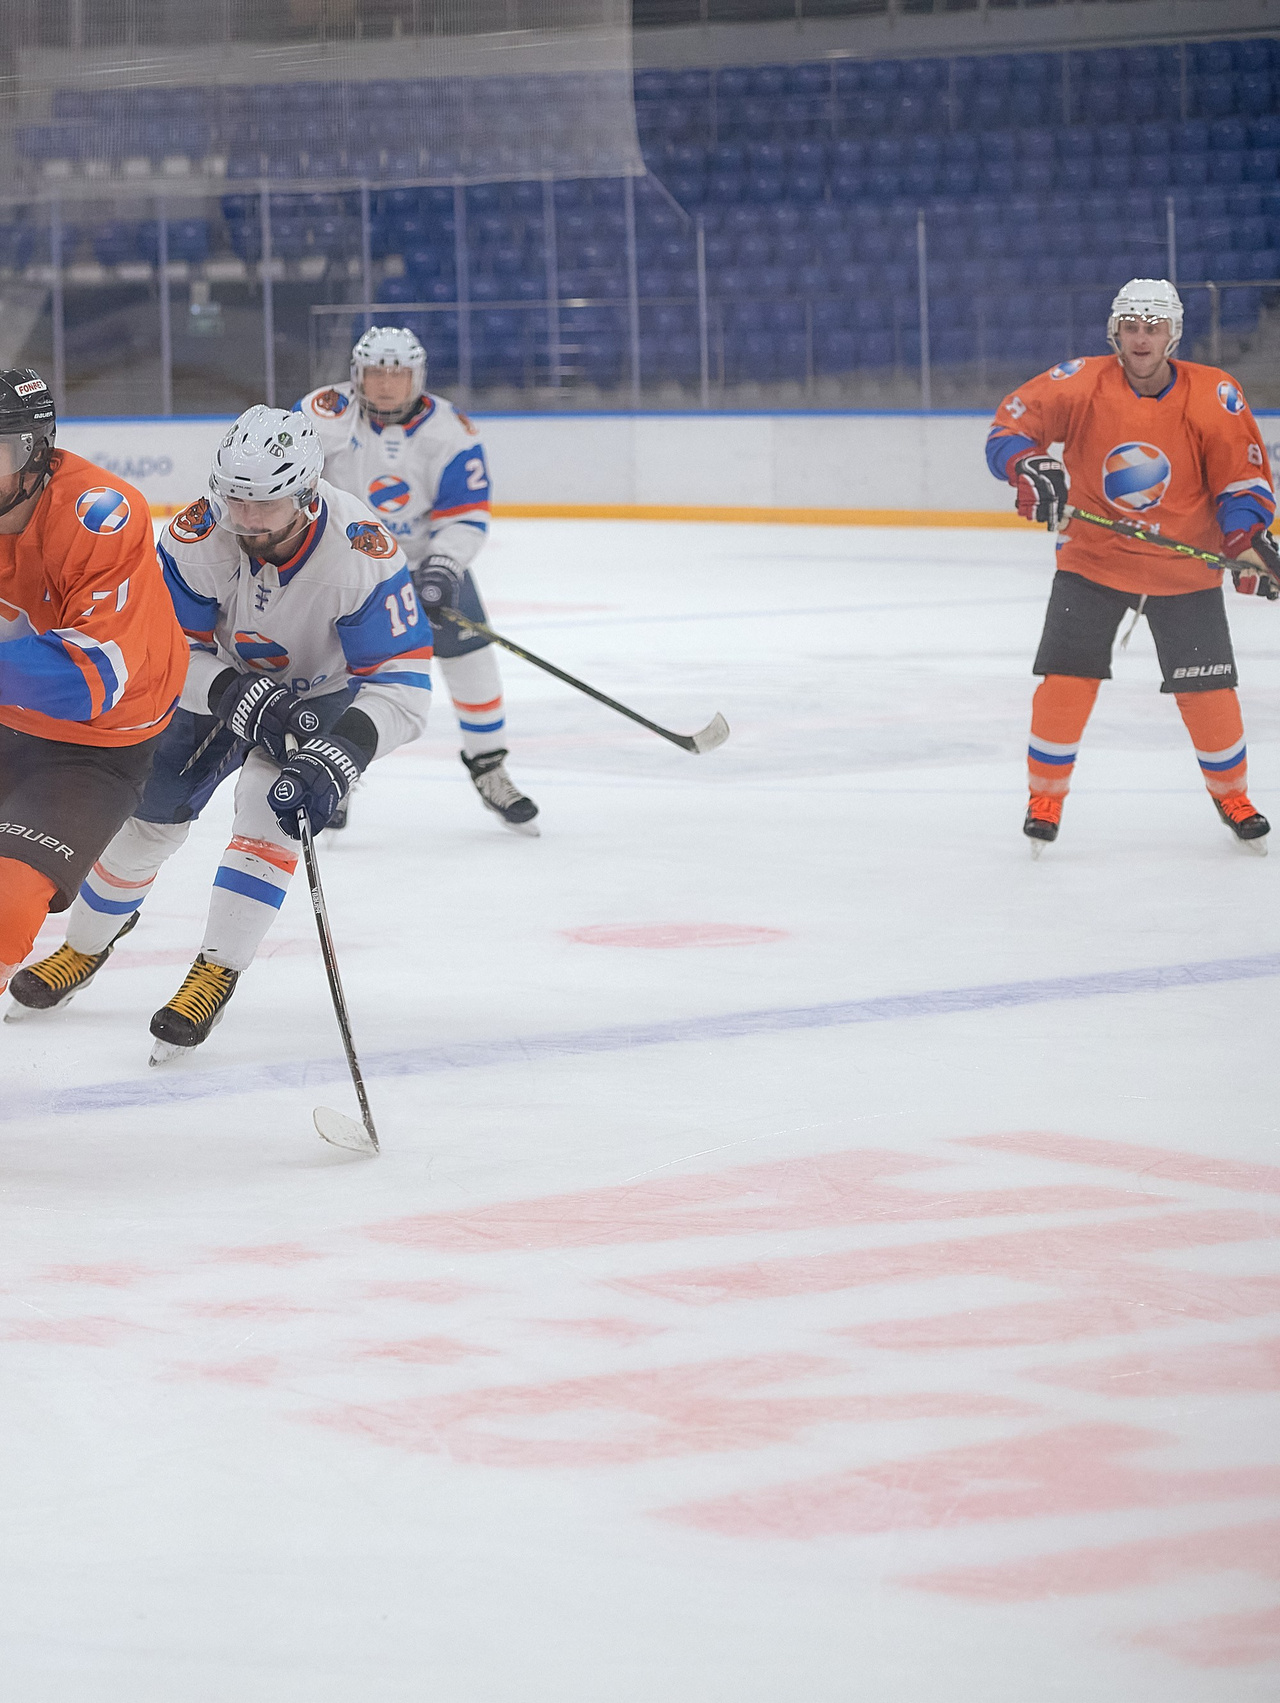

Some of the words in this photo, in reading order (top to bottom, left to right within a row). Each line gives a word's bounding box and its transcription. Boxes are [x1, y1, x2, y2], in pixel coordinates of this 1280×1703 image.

[34, 410, 54, 420] BAUER
[464, 457, 489, 492] 2
[384, 582, 419, 638] 19
[1173, 663, 1232, 679] BAUER
